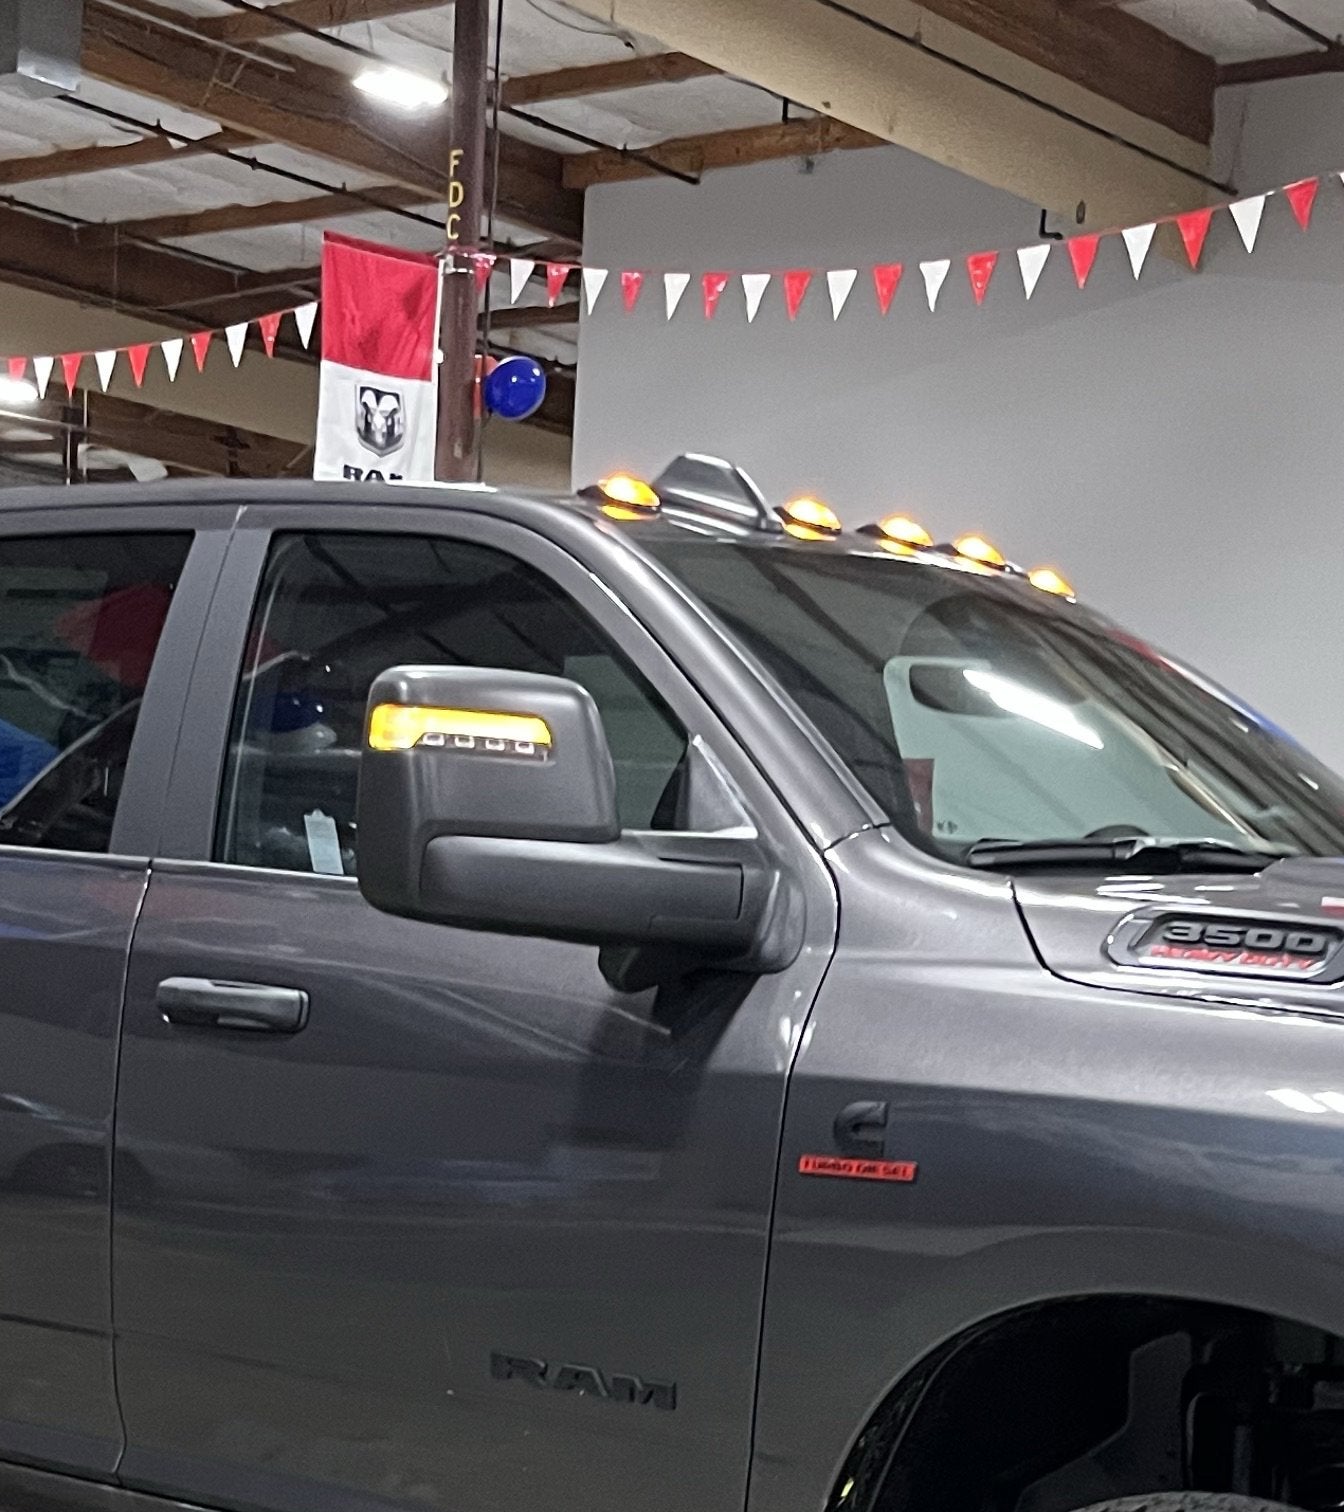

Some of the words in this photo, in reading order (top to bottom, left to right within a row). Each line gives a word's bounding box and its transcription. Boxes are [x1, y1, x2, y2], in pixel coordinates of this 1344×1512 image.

[446, 149, 464, 240] FDC
[1163, 921, 1327, 952] 3500
[490, 1352, 677, 1411] RAM
